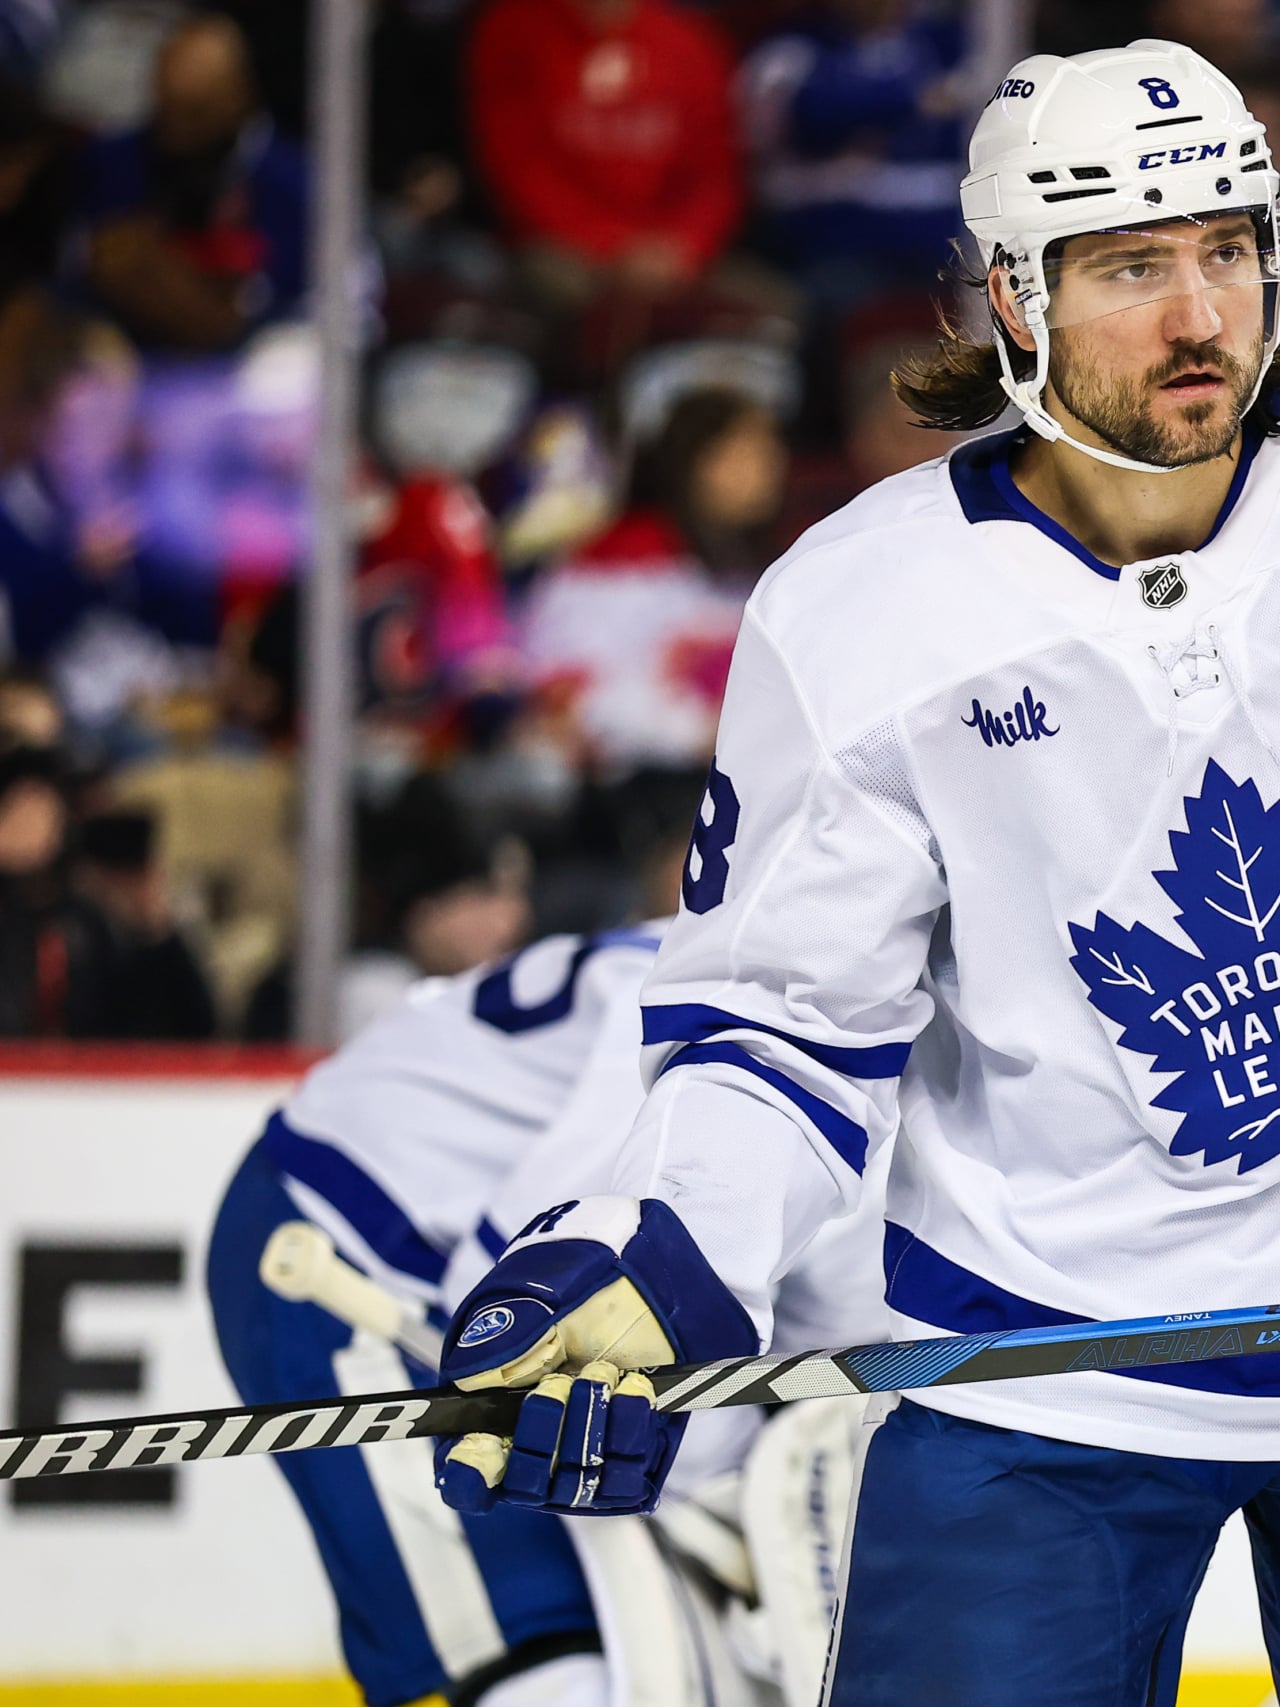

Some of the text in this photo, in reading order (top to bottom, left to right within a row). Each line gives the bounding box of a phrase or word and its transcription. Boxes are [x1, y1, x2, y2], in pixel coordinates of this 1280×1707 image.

[986, 79, 1035, 108] REO
[1138, 77, 1180, 110] 8
[1137, 141, 1228, 170] CCM
[1151, 572, 1176, 603] NHL
[681, 755, 741, 916] 8
[512, 1199, 581, 1240] R
[1164, 1312, 1212, 1324] TANEV
[1065, 1327, 1244, 1372] ALPHA
